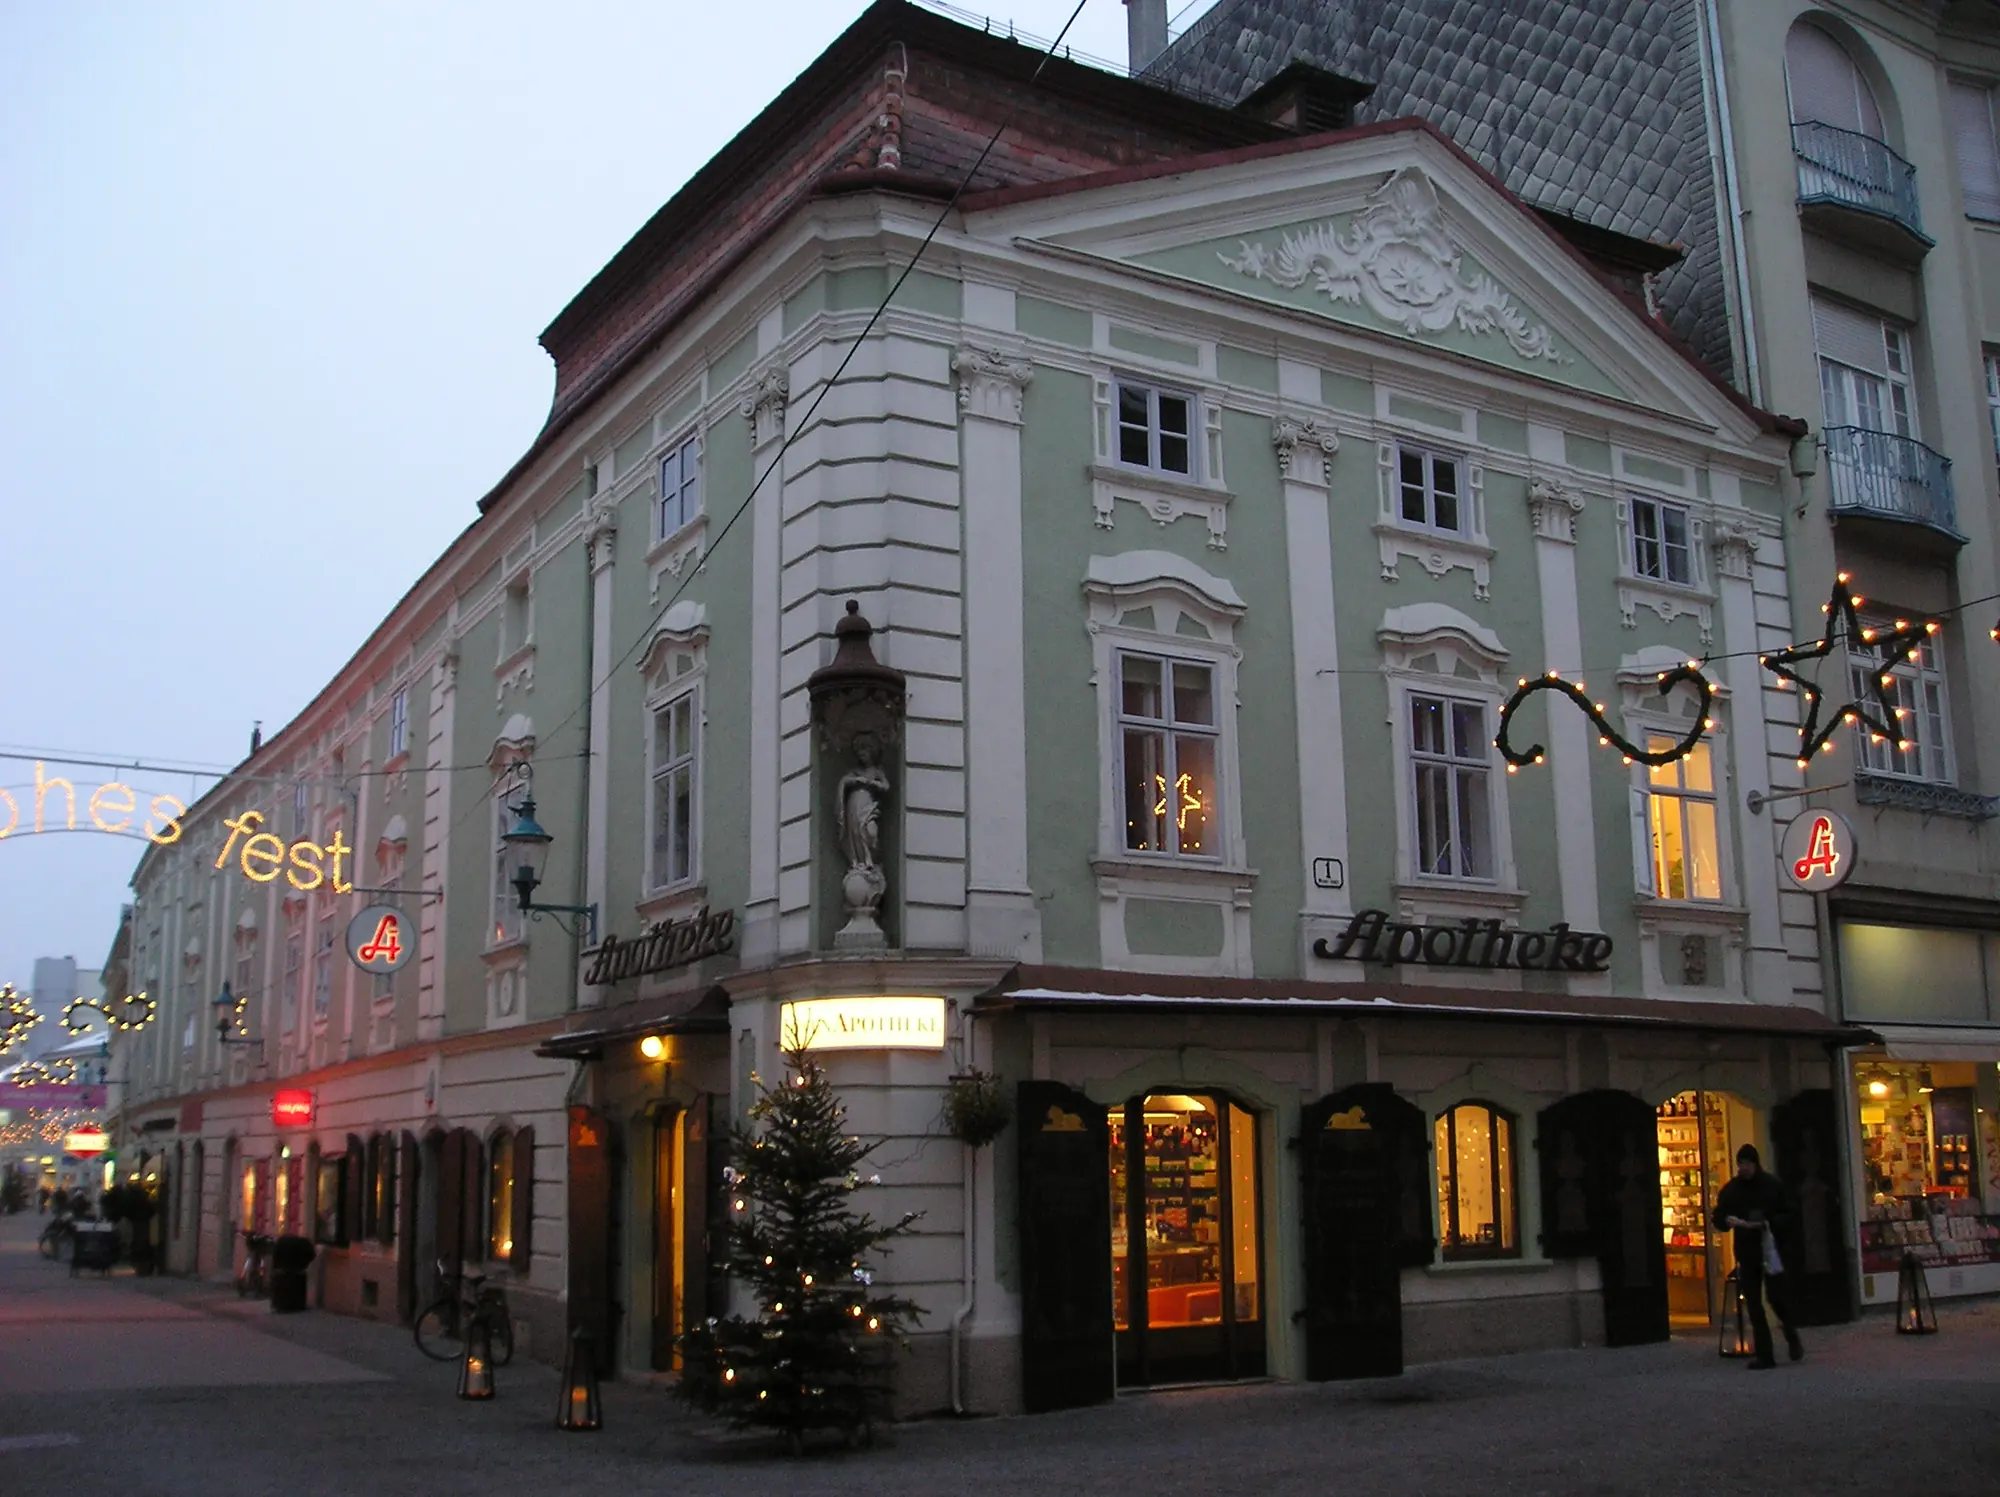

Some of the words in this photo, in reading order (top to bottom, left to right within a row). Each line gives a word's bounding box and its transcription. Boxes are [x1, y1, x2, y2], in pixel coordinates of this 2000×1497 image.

[214, 810, 353, 894] fest
[1325, 860, 1331, 879] 1
[584, 905, 735, 986] Apotheke
[1313, 908, 1614, 971] Apotheke
